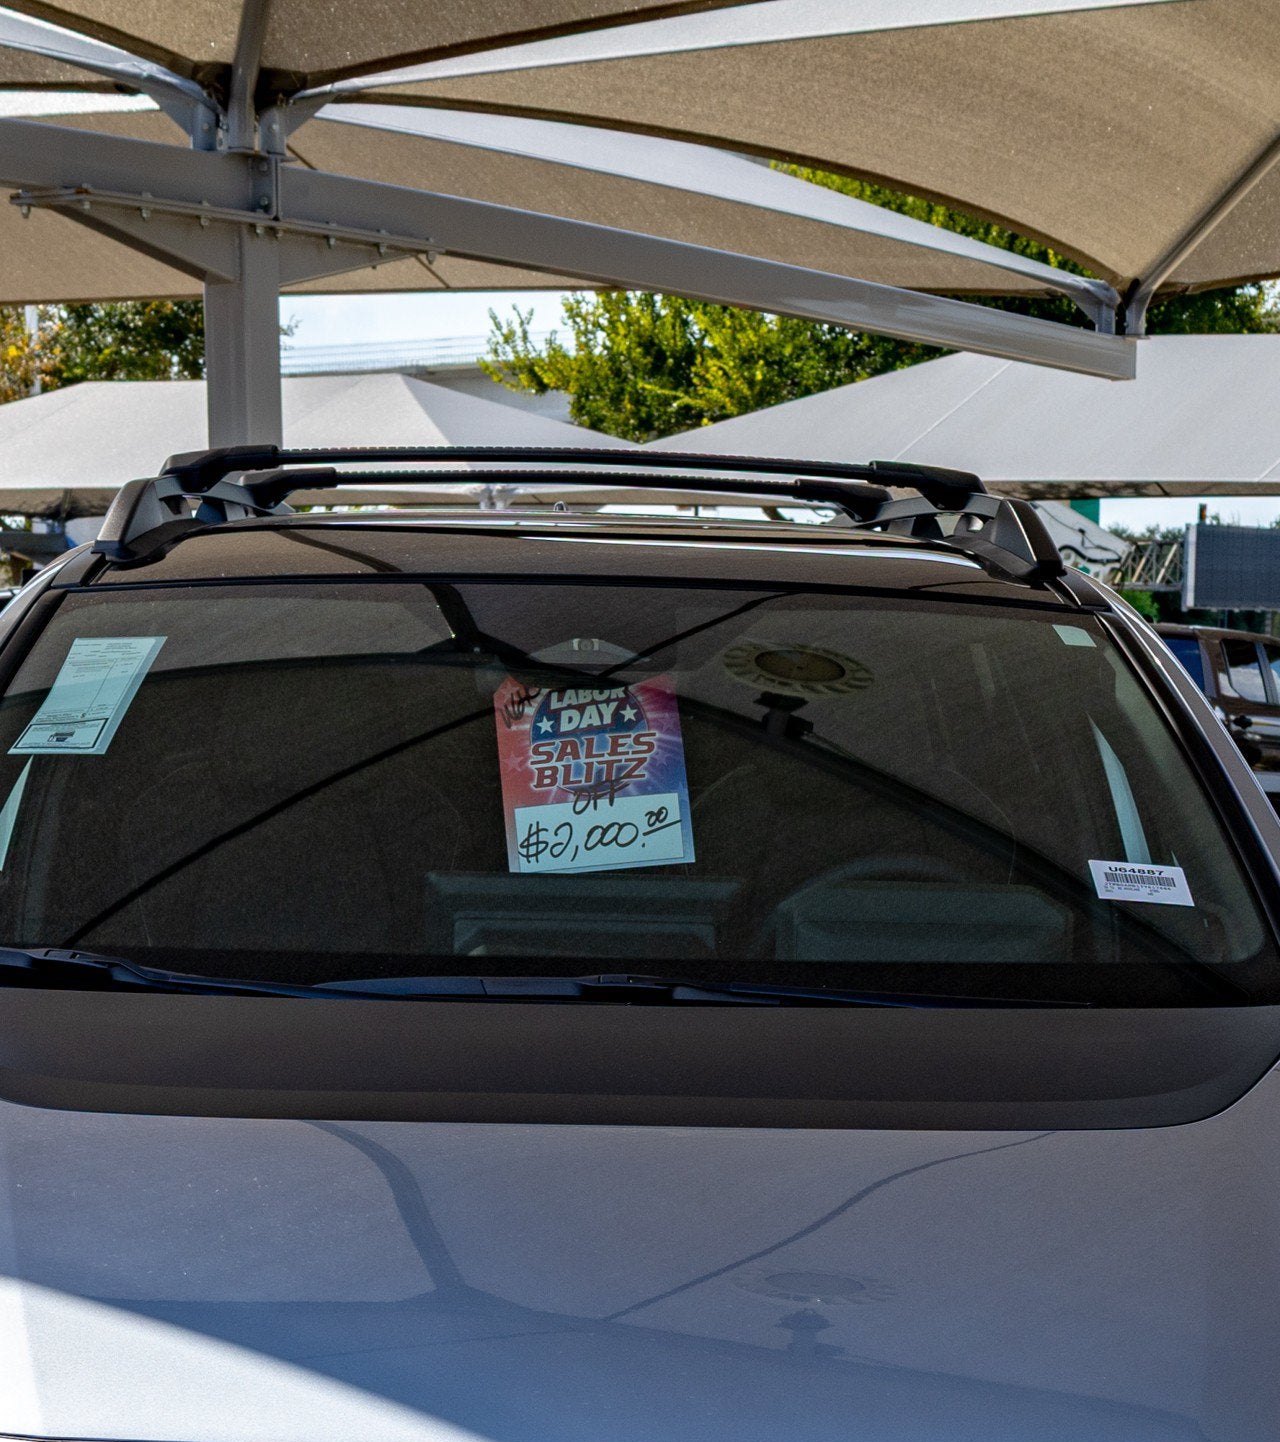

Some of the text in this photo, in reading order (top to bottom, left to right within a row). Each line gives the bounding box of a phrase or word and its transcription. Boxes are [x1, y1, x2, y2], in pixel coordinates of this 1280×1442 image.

[551, 686, 626, 709] LABOR
[560, 702, 618, 732] DAY
[530, 732, 658, 766] SALES
[532, 756, 647, 789] BLITZ
